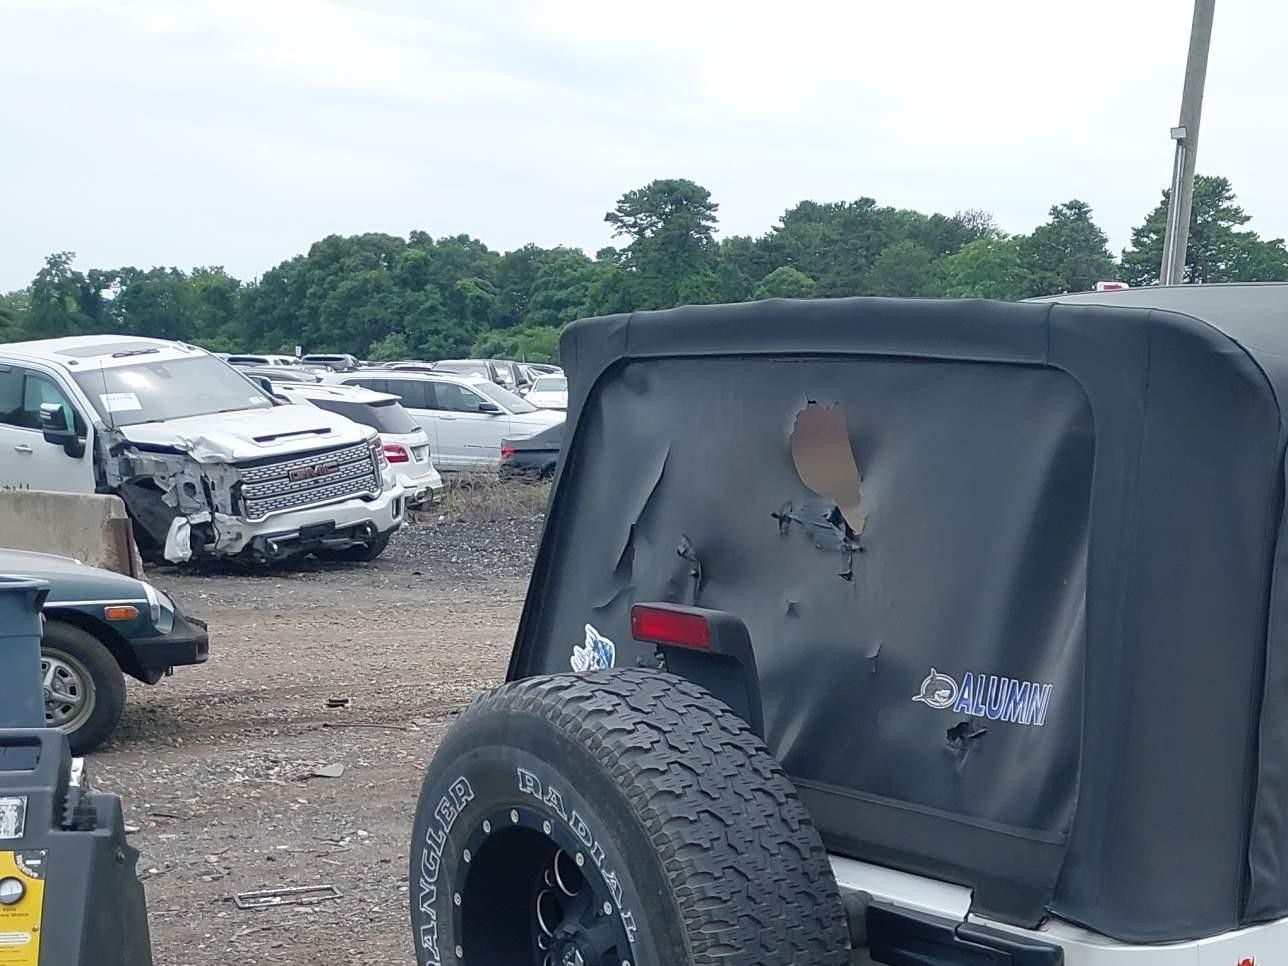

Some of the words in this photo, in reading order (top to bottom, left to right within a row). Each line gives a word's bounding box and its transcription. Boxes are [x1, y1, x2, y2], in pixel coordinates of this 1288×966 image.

[289, 460, 338, 483] GMC
[953, 671, 1053, 726] ALUMNI
[516, 767, 638, 943] RADIAL
